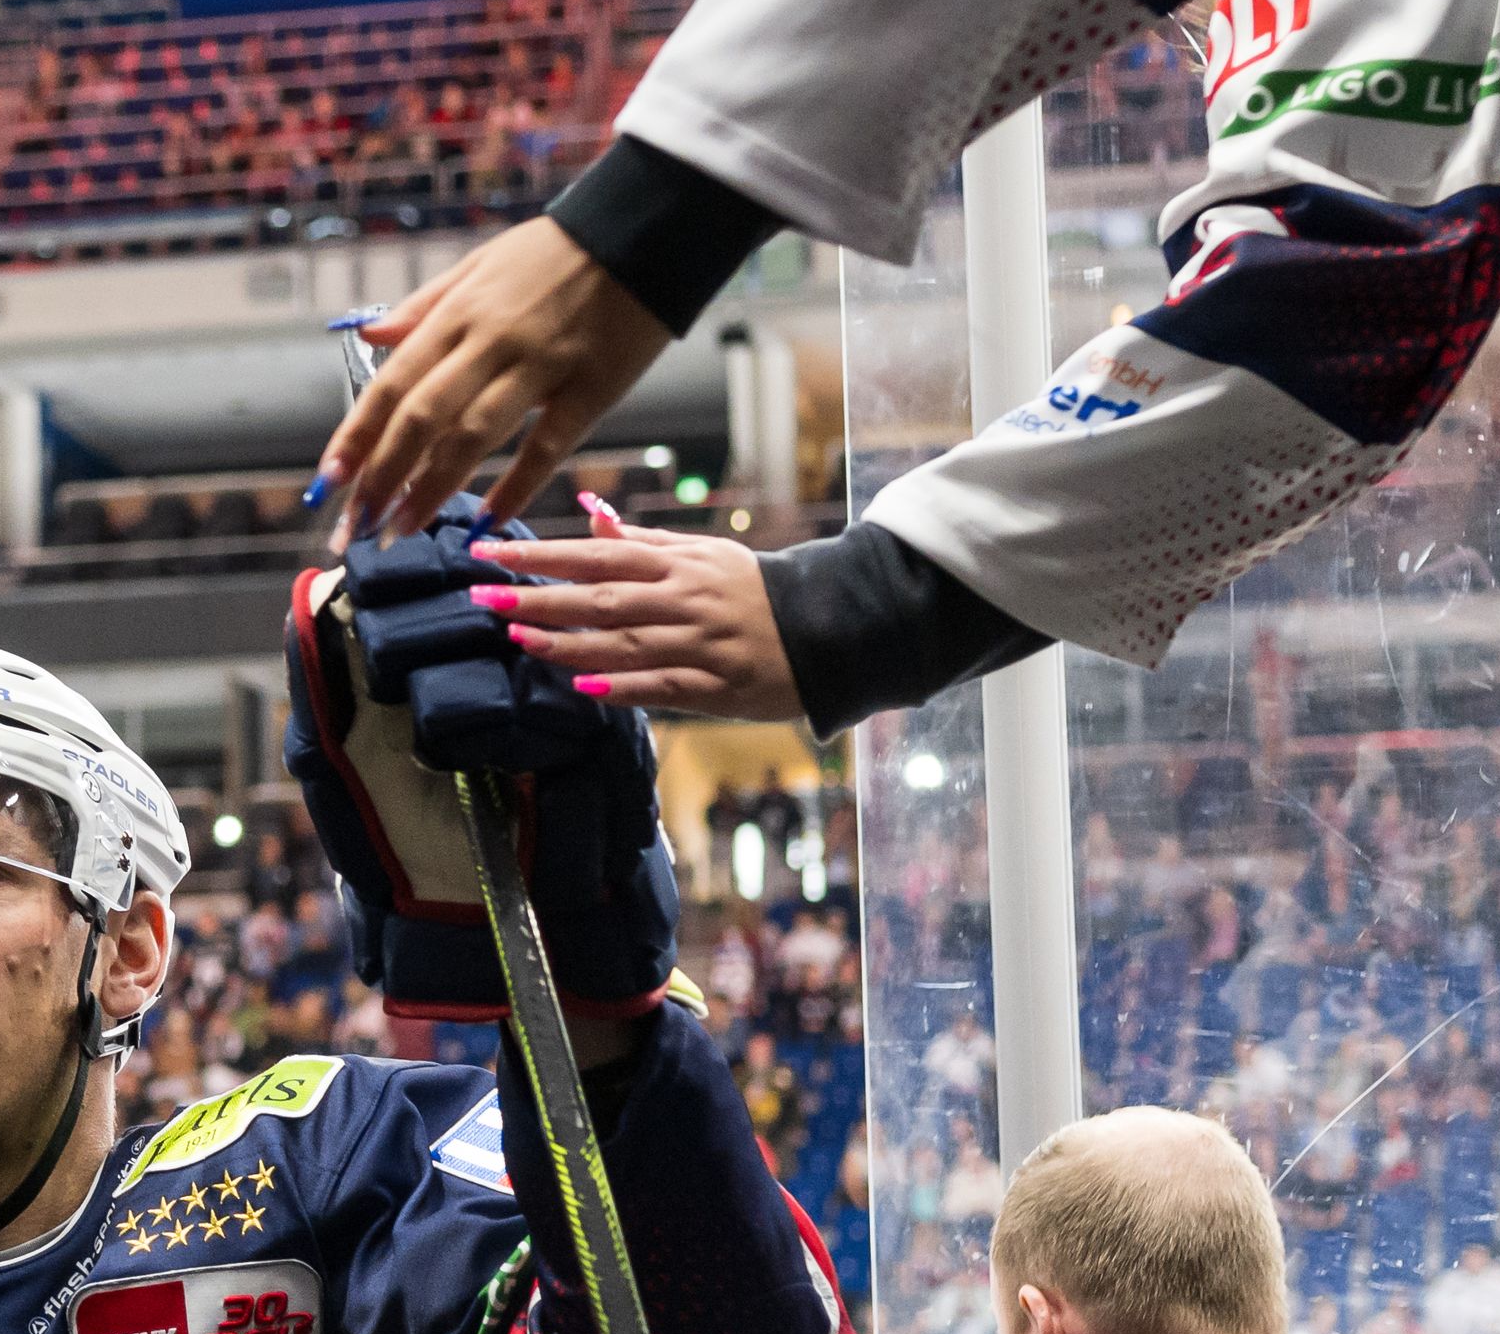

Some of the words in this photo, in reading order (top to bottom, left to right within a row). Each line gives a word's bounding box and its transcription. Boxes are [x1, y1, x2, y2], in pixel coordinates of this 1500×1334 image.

[1289, 68, 1408, 109] LIGO
[61, 748, 159, 817] STADLER
[184, 1127, 219, 1155] 1921
[221, 1290, 290, 1332] 30
